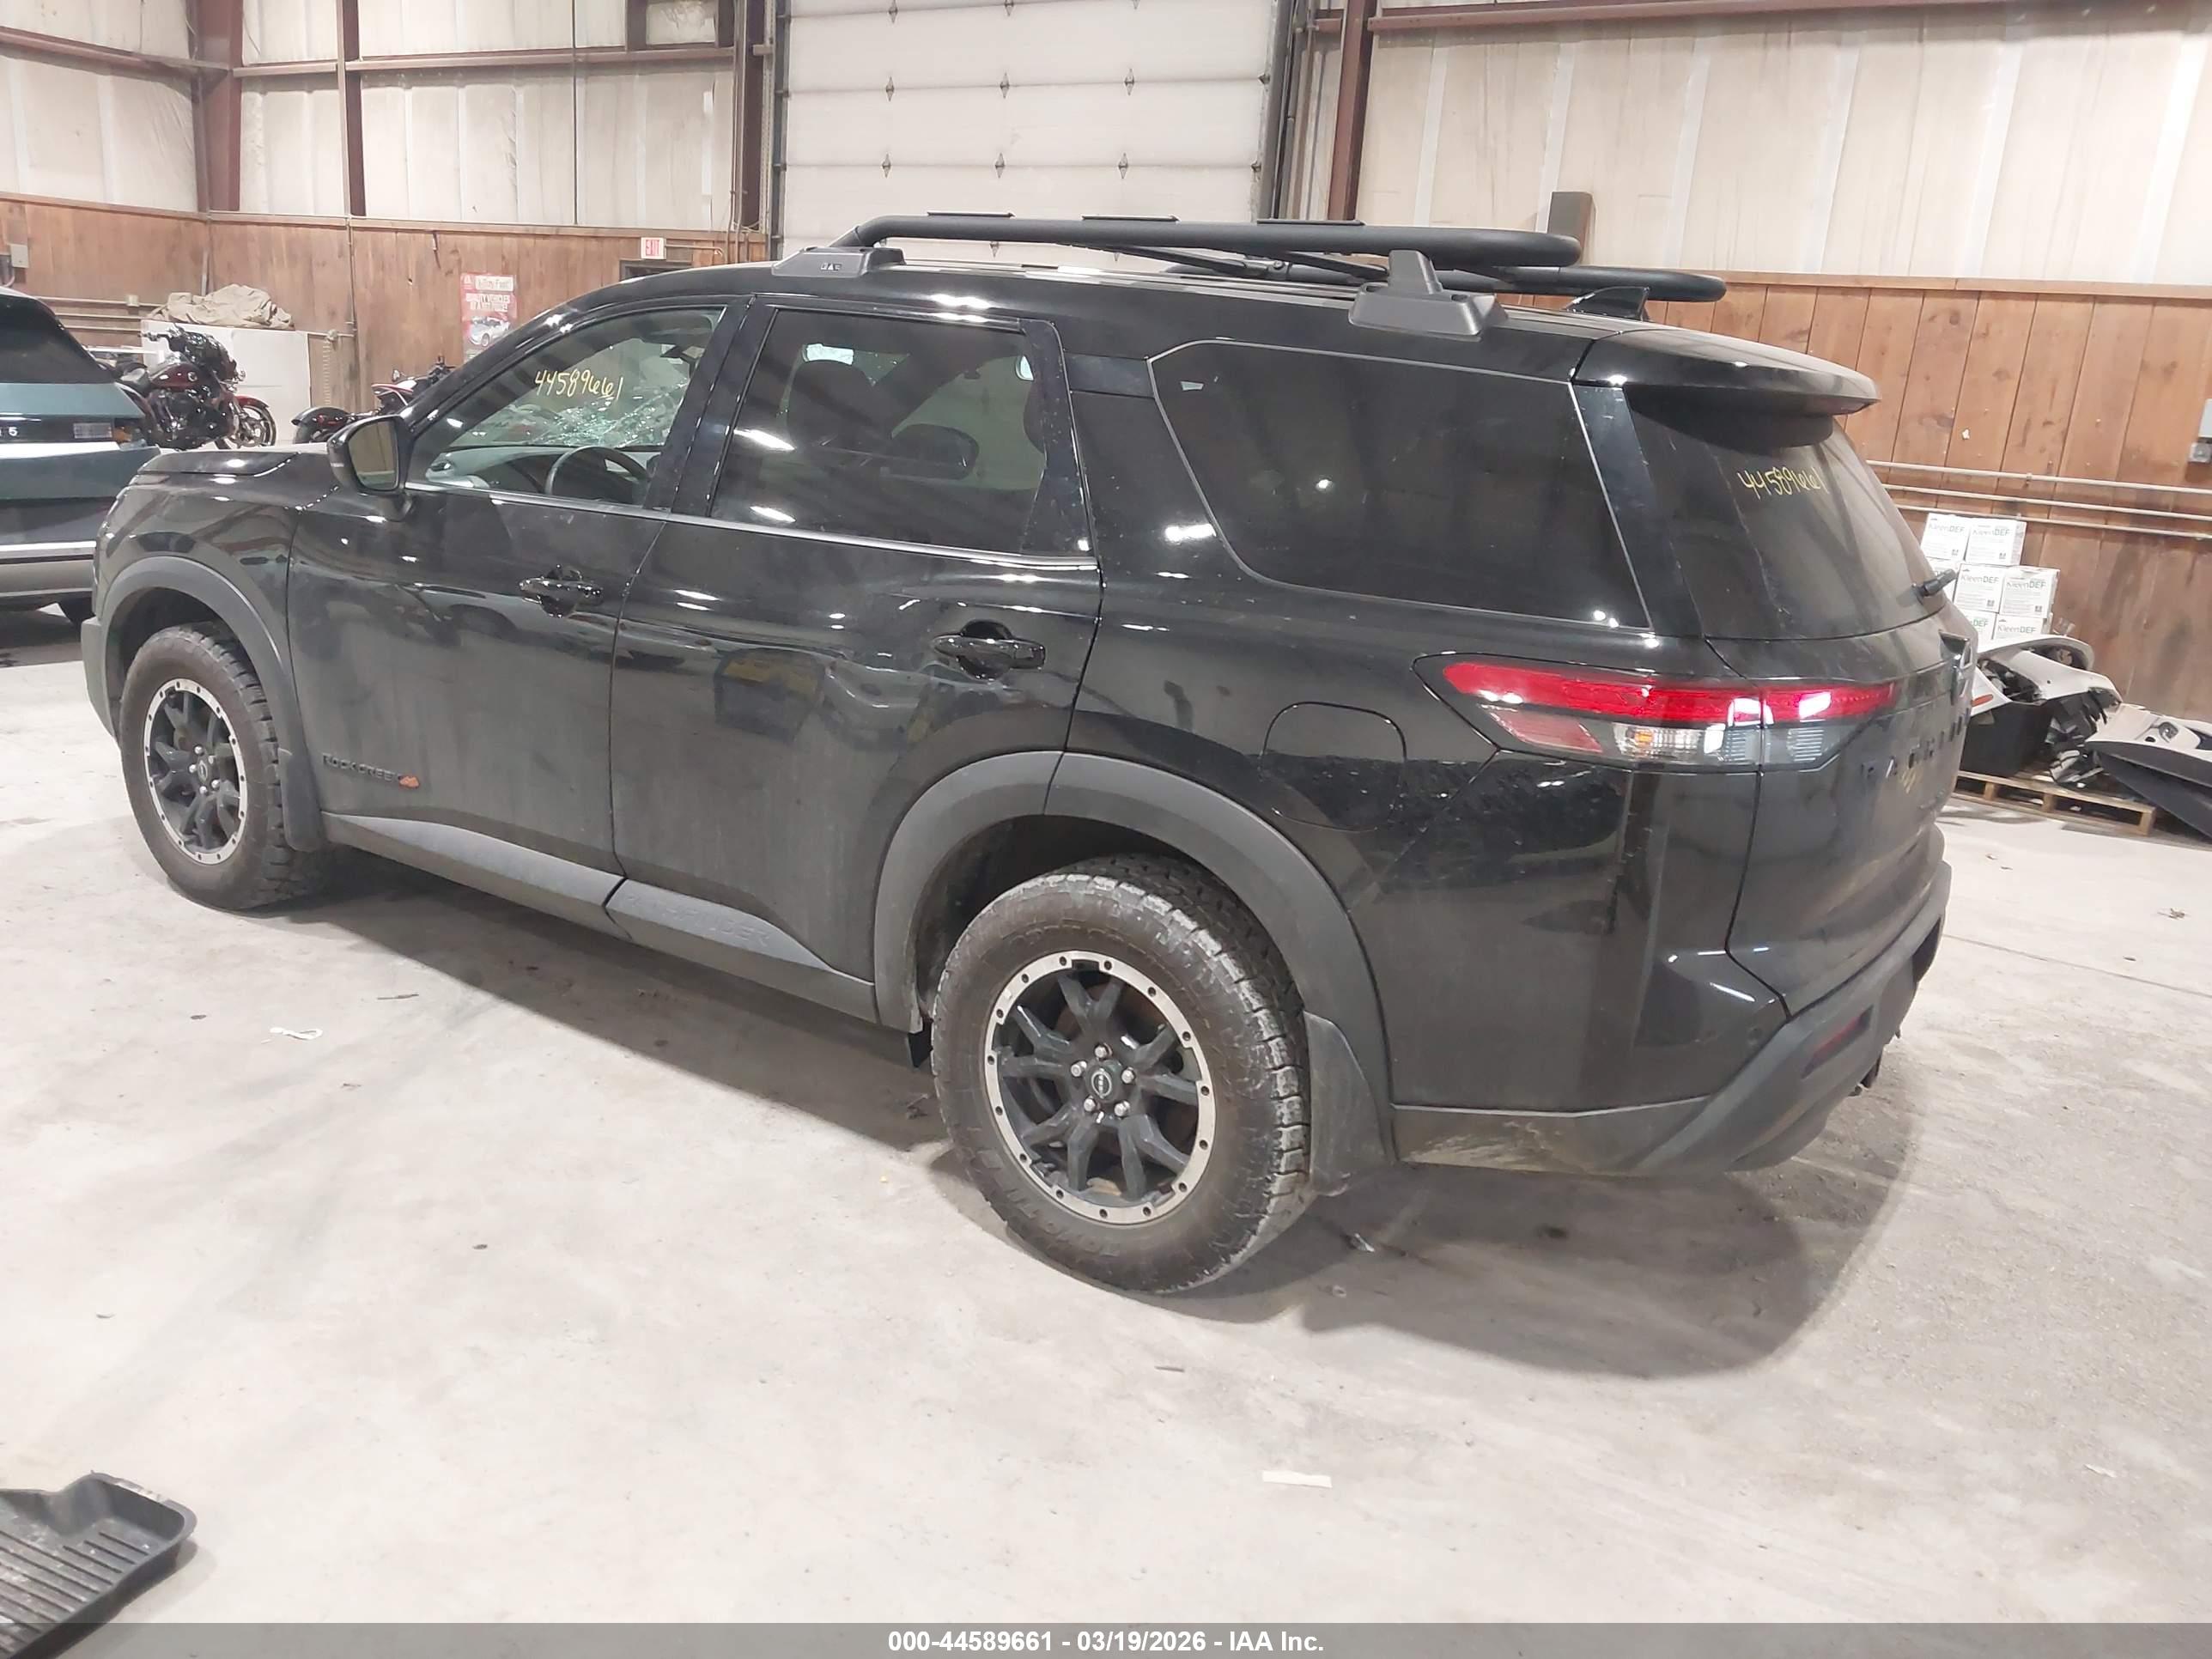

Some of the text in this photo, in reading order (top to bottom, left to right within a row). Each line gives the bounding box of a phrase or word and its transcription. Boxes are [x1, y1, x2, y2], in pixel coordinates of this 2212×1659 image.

[534, 368, 624, 401] 44589661
[1961, 574, 2000, 584] KleenDEF
[1997, 624, 2036, 634] KleenDEF
